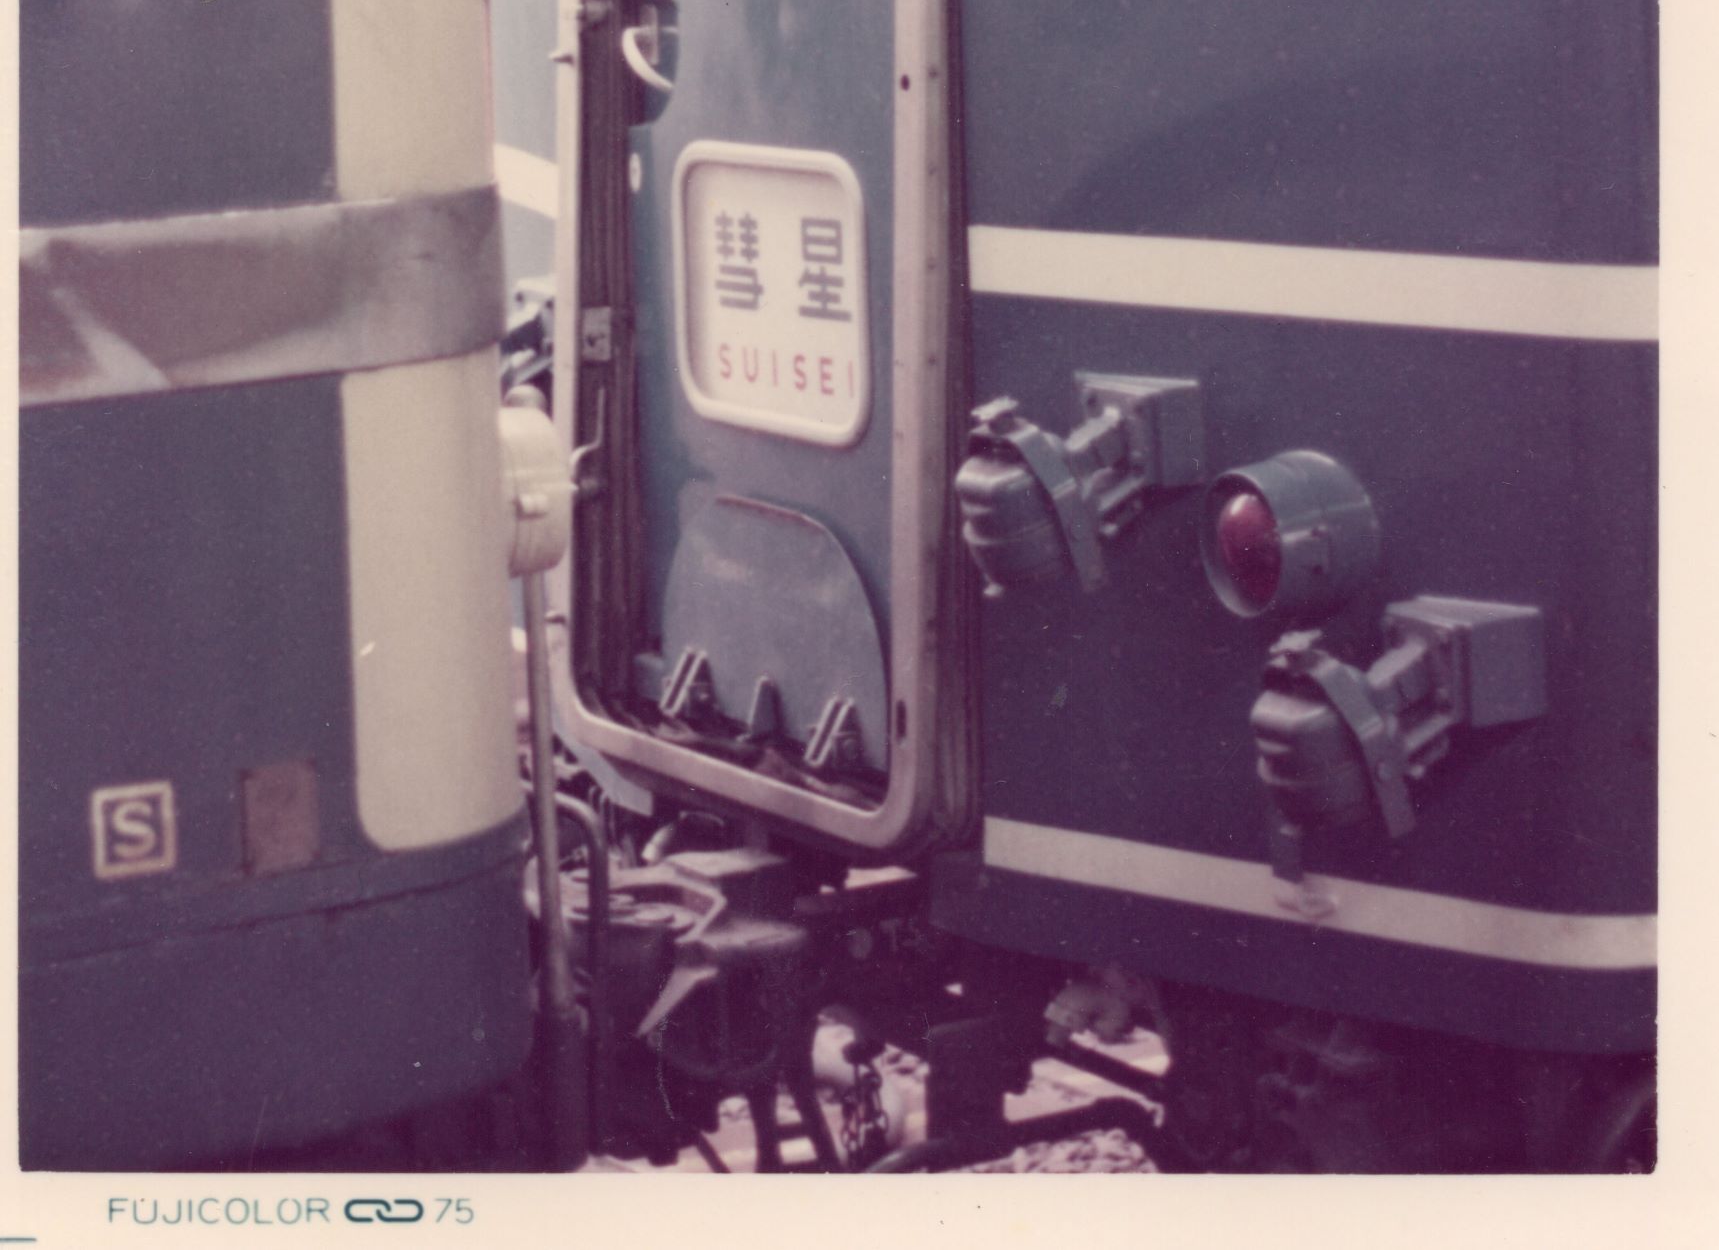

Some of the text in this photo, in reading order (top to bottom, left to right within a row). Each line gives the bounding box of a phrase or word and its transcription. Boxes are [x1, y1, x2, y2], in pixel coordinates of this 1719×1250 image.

[714, 210, 852, 323] 彗星
[717, 342, 856, 399] SUISEI
[111, 799, 157, 859] S
